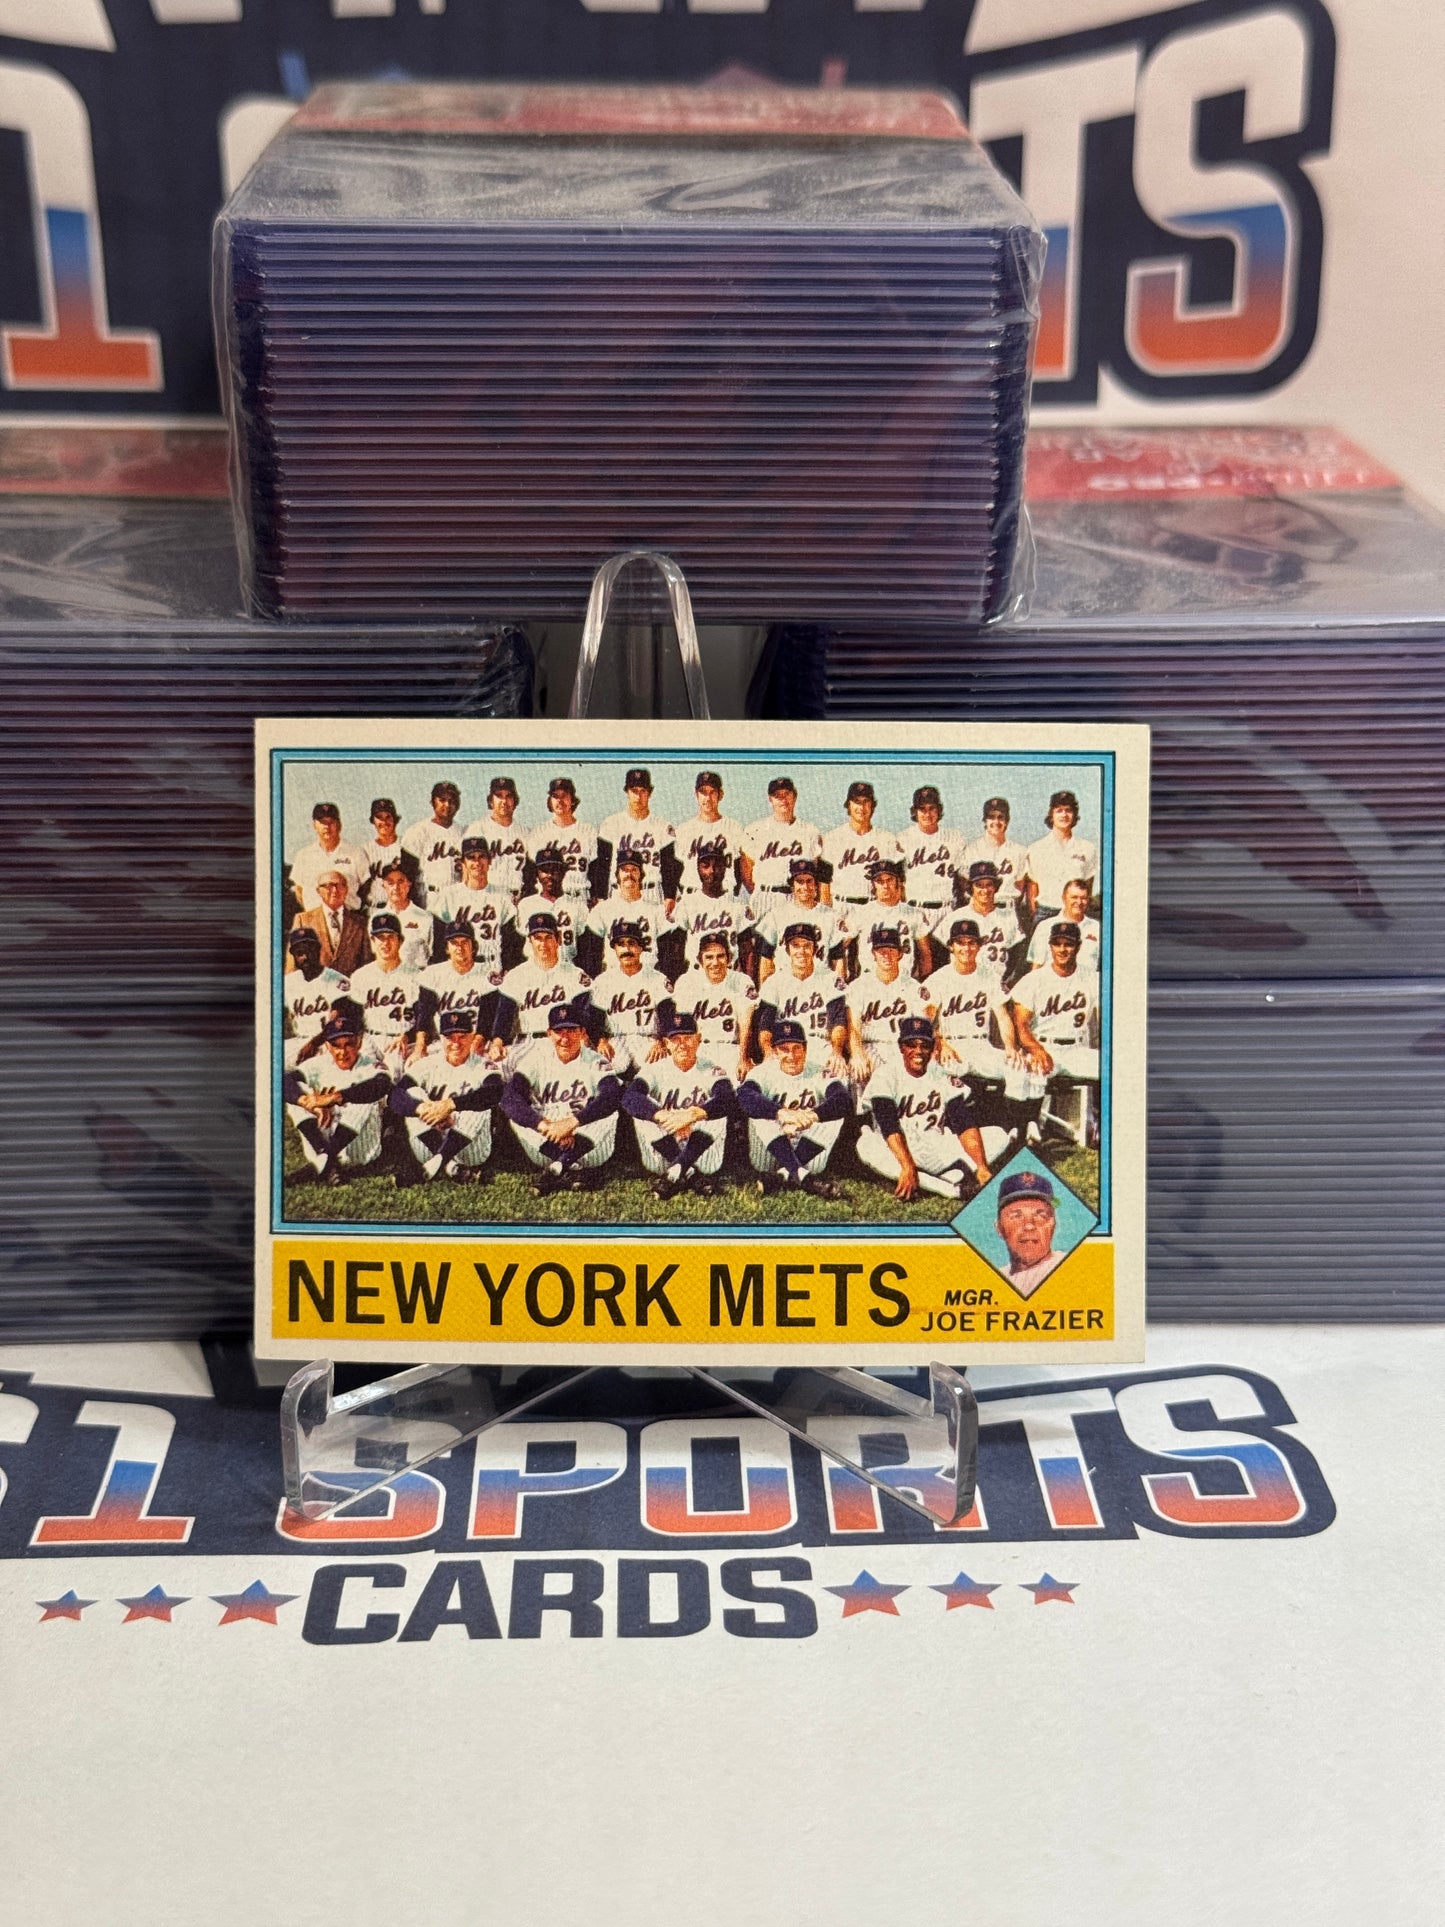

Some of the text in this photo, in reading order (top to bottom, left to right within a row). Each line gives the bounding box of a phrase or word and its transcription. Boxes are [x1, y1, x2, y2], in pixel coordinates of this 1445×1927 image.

[760, 840, 802, 861] Mets
[838, 845, 881, 869] Mets
[908, 845, 951, 869] Mets
[479, 922, 499, 941] 31
[690, 910, 733, 935] Mets
[293, 995, 330, 1017] Mets
[364, 986, 406, 1010] Mets
[439, 988, 481, 1012] Mets
[520, 984, 566, 1011] Mets
[607, 988, 651, 1016] Mets
[693, 998, 734, 1021] Mets
[780, 991, 824, 1019] Mets
[861, 996, 907, 1022] Mets
[942, 990, 988, 1017] Mets
[1039, 990, 1087, 1017] Mets
[634, 1008, 656, 1027] 17
[809, 1012, 829, 1030] 15
[974, 1011, 987, 1028] 5
[1072, 1012, 1087, 1028] 9
[539, 1079, 588, 1105] Mets
[660, 1085, 709, 1110] Mets
[897, 1089, 941, 1119] Mets
[288, 1259, 911, 1328] NEW YORK METS
[944, 1289, 999, 1306] MGR.
[920, 1309, 1104, 1332] JOE FRAZIER
[275, 1373, 1308, 1543] SPORTS
[301, 1556, 818, 1646] CARDS
